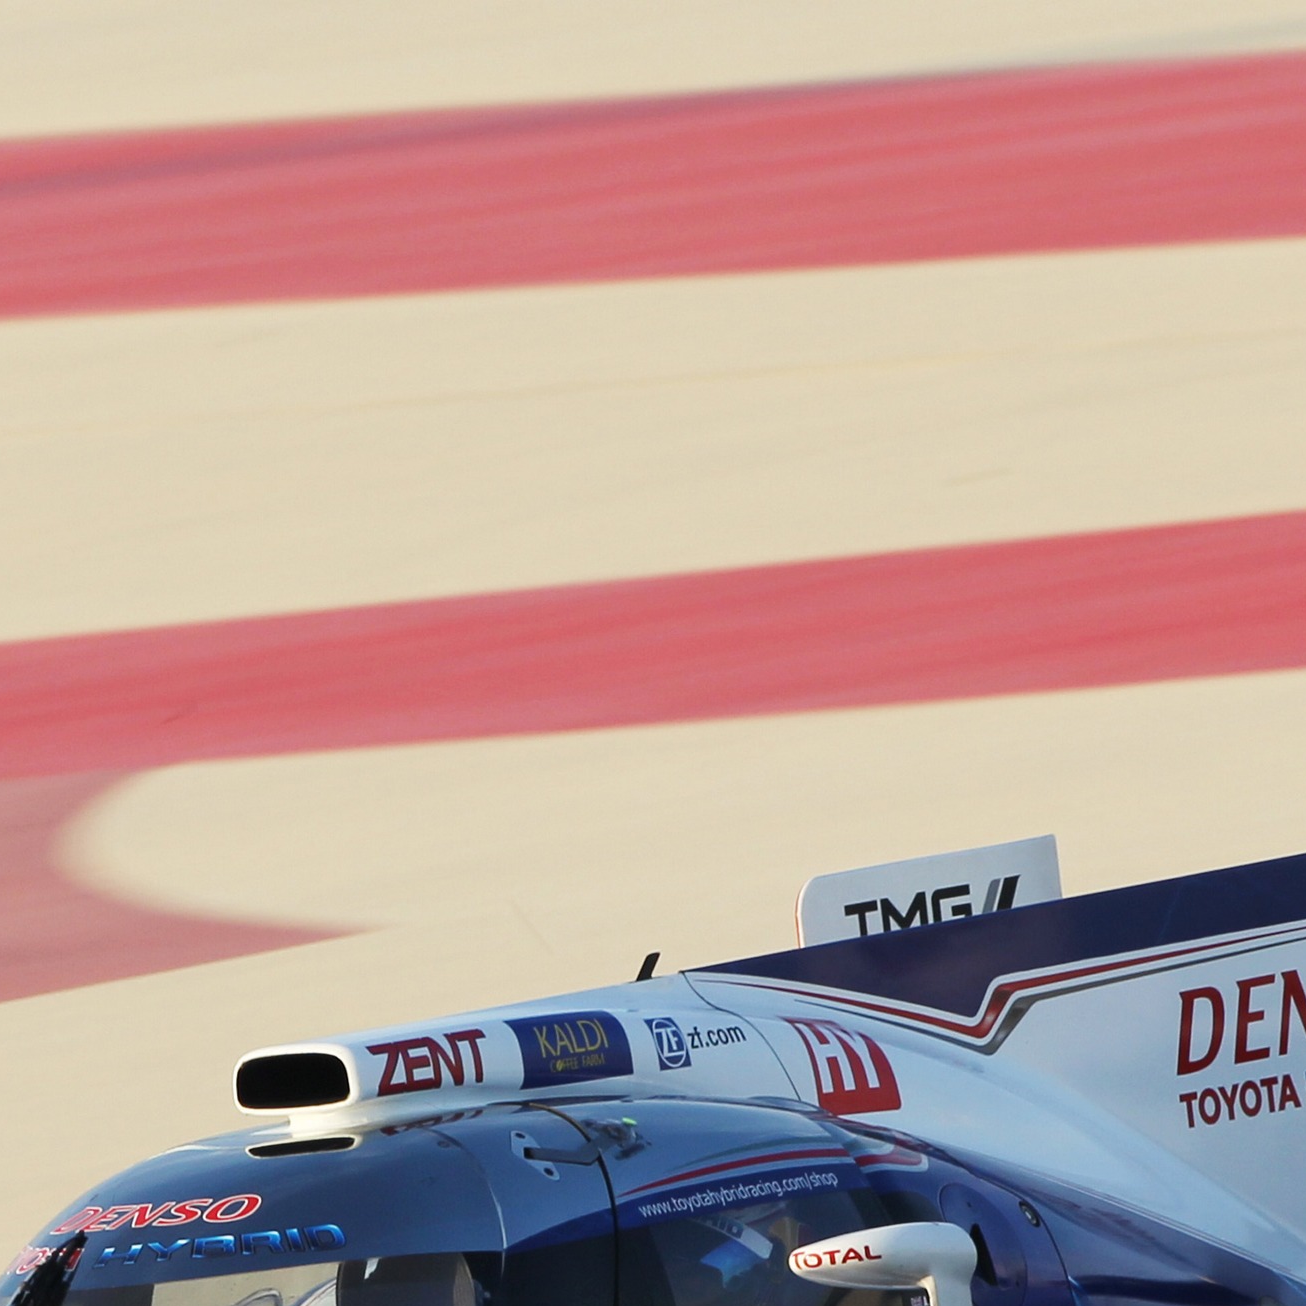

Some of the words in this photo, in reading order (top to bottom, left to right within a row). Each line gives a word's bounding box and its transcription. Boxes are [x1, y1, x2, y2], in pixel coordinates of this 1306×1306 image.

[844, 884, 973, 936] TMG
[533, 1018, 610, 1059] KALDI
[654, 1028, 682, 1058] ZF
[687, 1023, 747, 1050] zf.com
[365, 1028, 486, 1096] ZENT
[1179, 1074, 1302, 1128] TOYOTA
[50, 1193, 262, 1235] DENSO
[638, 1172, 839, 1218] www.toyotahybridracing.com/shop
[93, 1224, 346, 1268] HYBRID
[792, 1244, 882, 1271] TOTAL
